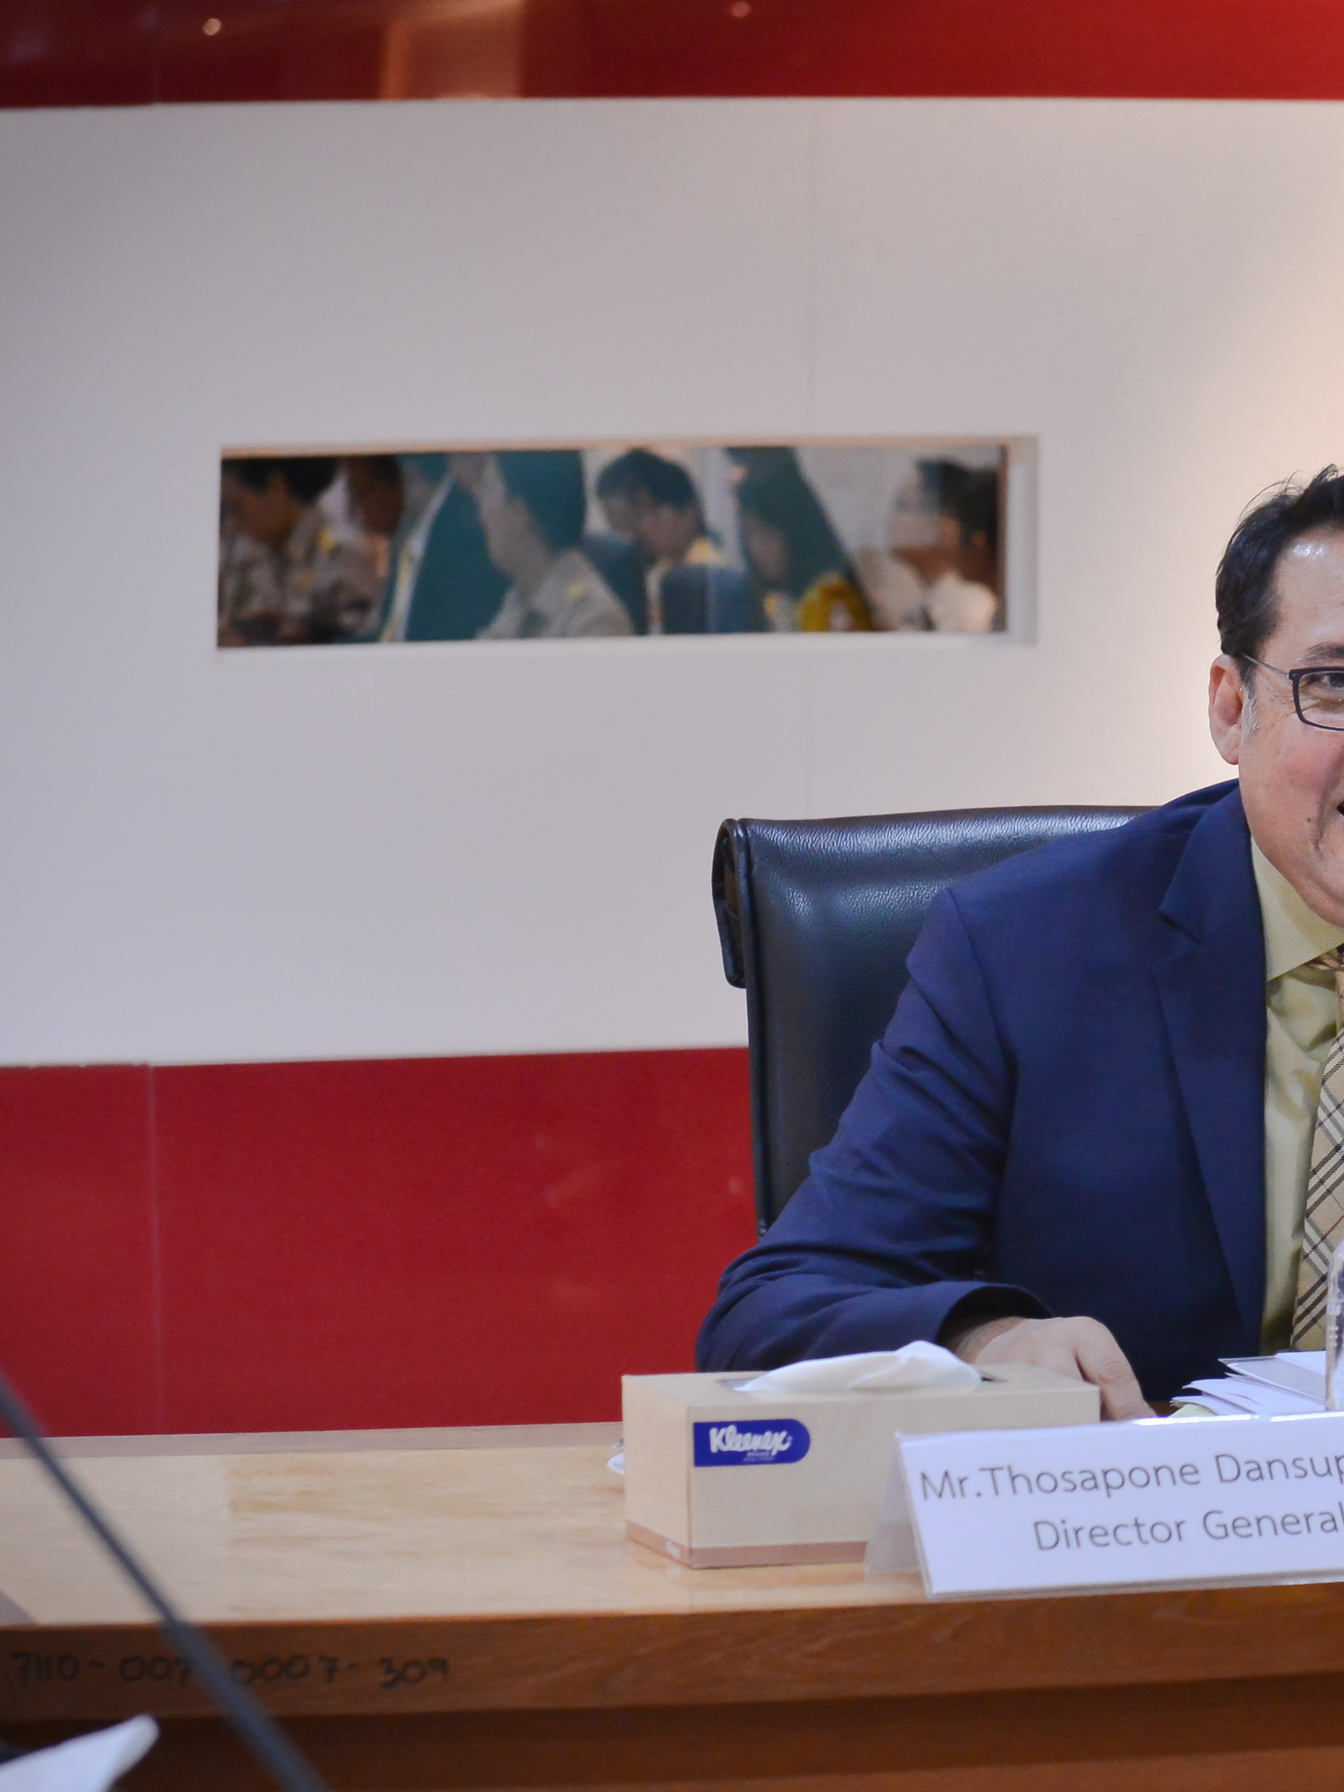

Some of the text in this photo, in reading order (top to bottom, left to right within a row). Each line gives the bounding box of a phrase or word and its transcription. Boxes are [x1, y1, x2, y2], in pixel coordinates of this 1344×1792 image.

[709, 1424, 793, 1456] Kleenex
[920, 1463, 1200, 1500] Mr.Thosapone
[1034, 1517, 1186, 1551] Director
